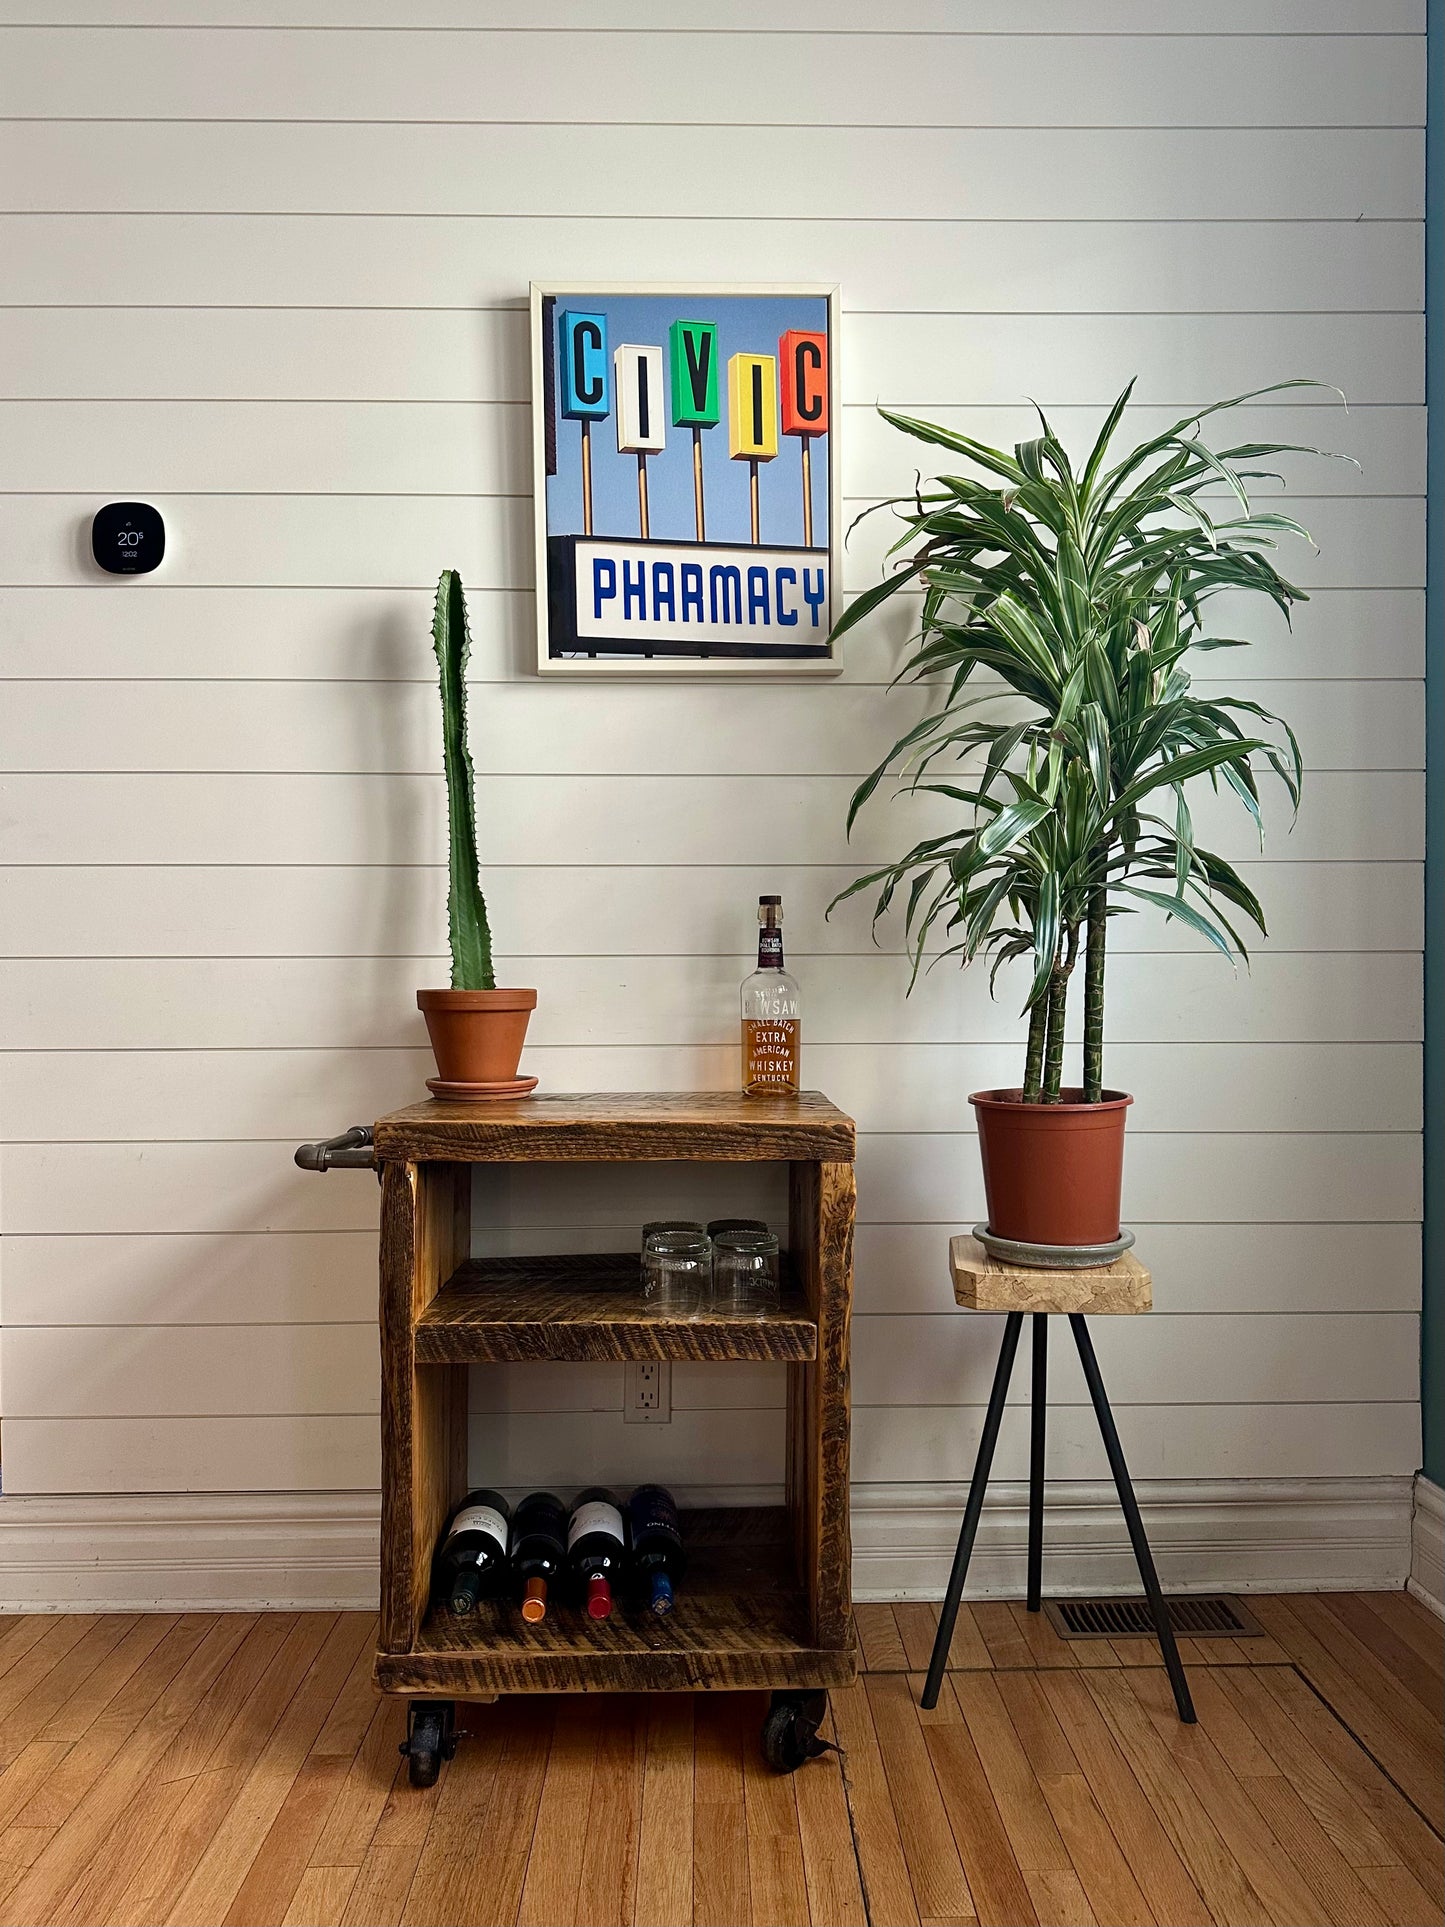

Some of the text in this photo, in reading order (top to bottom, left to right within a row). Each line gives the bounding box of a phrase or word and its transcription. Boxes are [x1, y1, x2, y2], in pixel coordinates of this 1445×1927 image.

[573, 320, 823, 446] CIVIC
[592, 557, 824, 627] PHARMACY
[773, 1018, 794, 1034] BATCH
[756, 1031, 787, 1043] EXTRA
[753, 1045, 790, 1058] AMERICAN
[750, 1060, 794, 1071] WHISKEY
[753, 1074, 789, 1082] KENTUCKY
